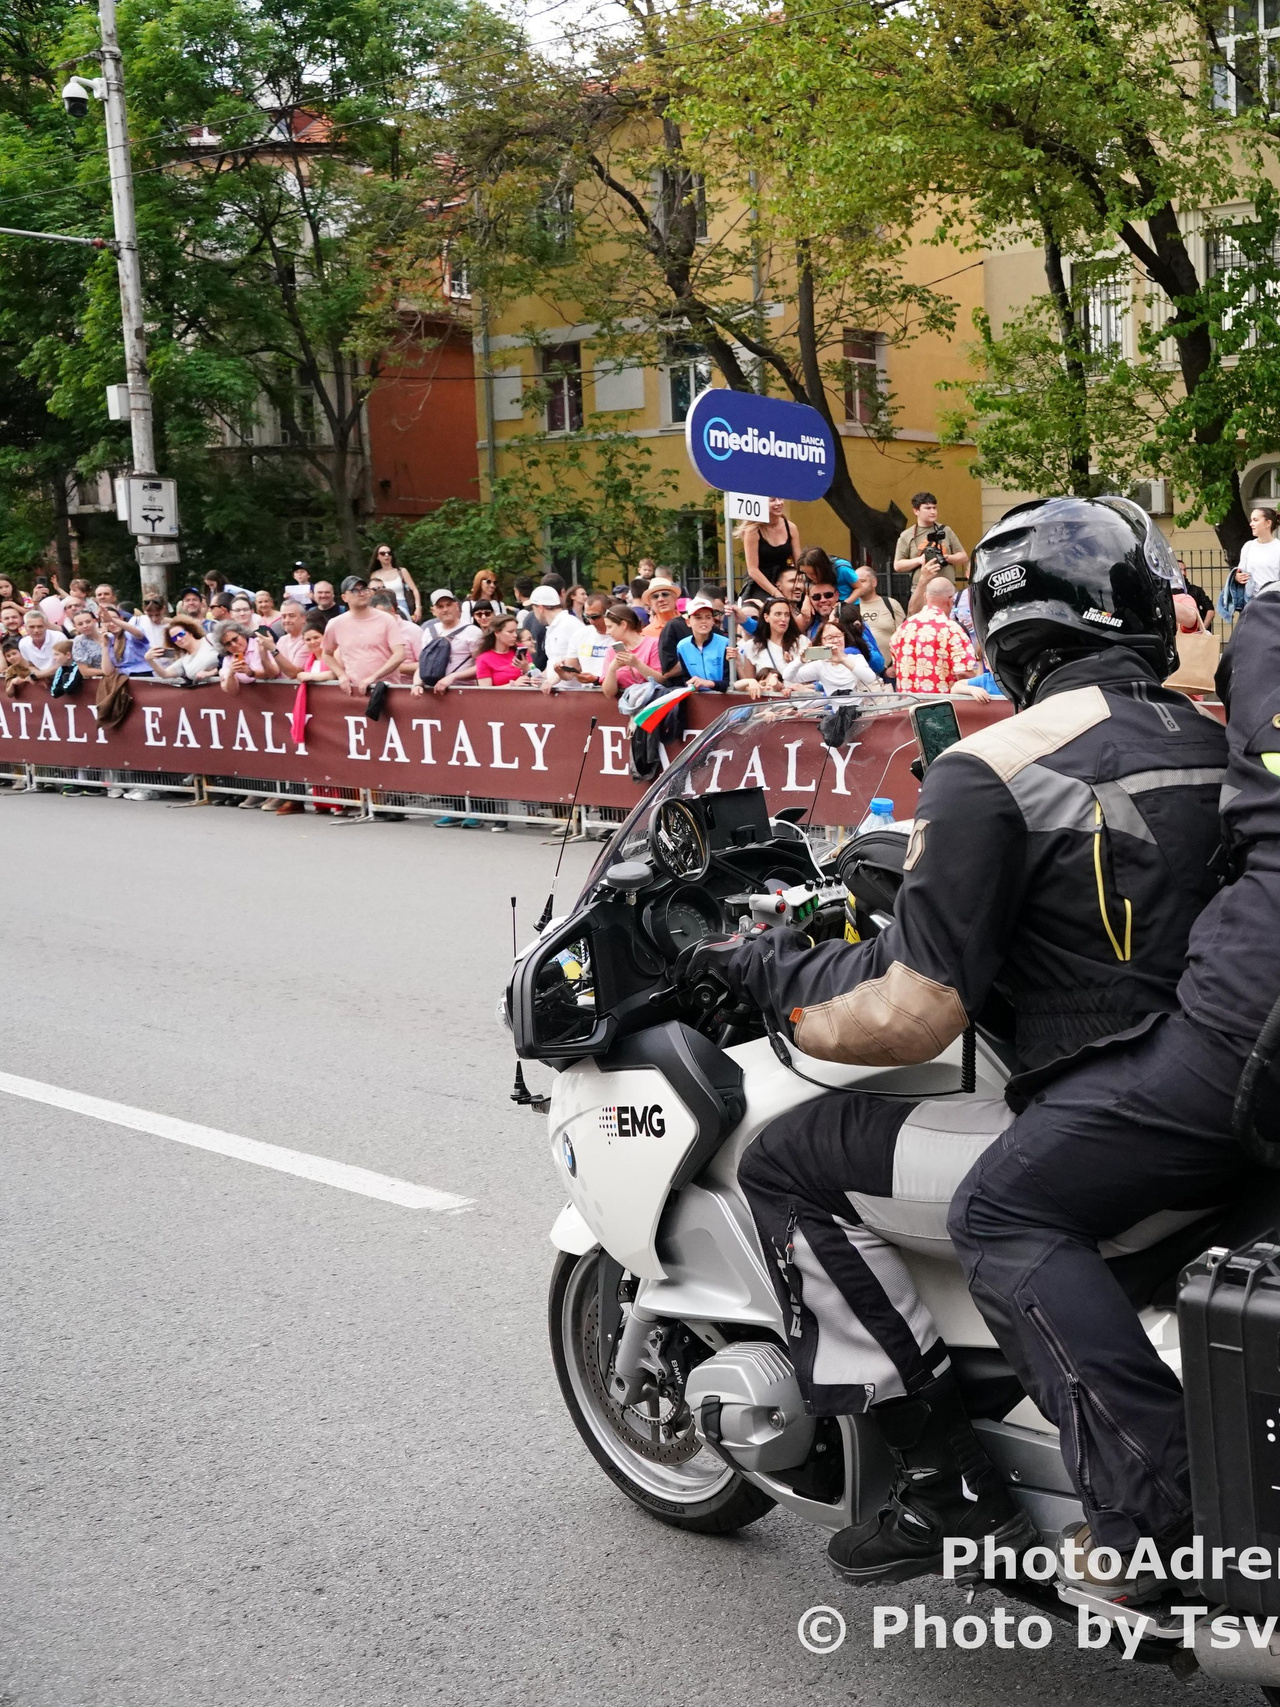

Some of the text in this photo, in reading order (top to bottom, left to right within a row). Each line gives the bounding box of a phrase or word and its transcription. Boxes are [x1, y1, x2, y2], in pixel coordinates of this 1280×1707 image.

[709, 427, 826, 464] mediolanum
[801, 434, 825, 447] BANCA
[737, 498, 761, 517] 700
[992, 566, 1022, 588] SHOEI
[344, 715, 556, 771] EATALY
[598, 725, 862, 796] ETALY
[617, 1104, 666, 1138] EMG
[671, 1359, 684, 1385] BMW
